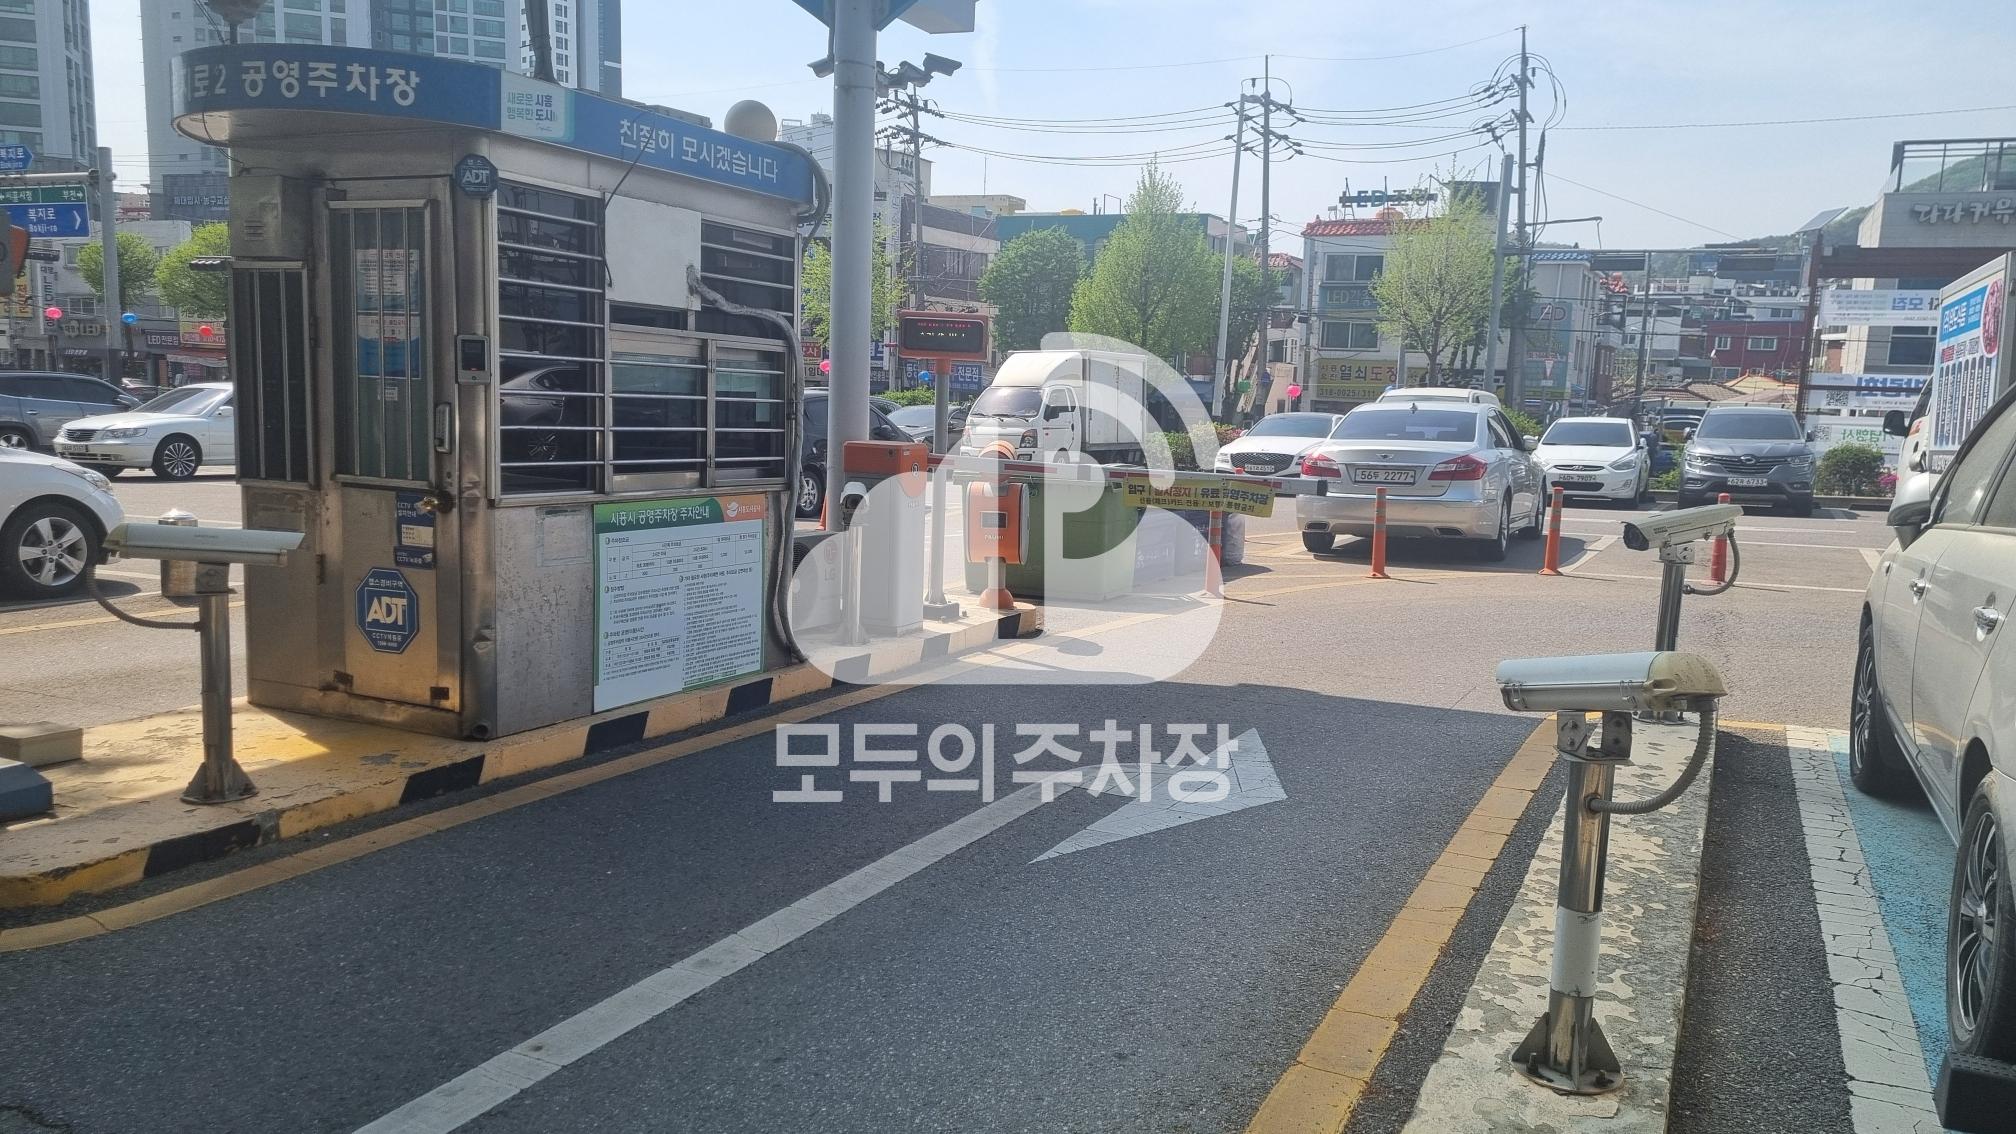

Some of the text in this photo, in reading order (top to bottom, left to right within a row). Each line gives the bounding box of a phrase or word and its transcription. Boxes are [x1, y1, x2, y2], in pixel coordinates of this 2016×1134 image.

[241, 60, 421, 107] 공영주차장
[507, 91, 553, 108] 새로운 시흥
[507, 107, 533, 121] 행복한
[618, 117, 779, 184] 친절히 모시겠습니다
[462, 169, 490, 184] ADT
[28, 207, 57, 222] 복지로
[28, 224, 58, 234] Bokji-ro
[957, 366, 979, 382] 전문점
[1383, 471, 1410, 481] 2277
[1127, 484, 1146, 495] 입구
[1200, 487, 1220, 499] 유료
[610, 505, 710, 527] 시흥시 공영주차장 주차안내
[366, 595, 408, 626] ADT
